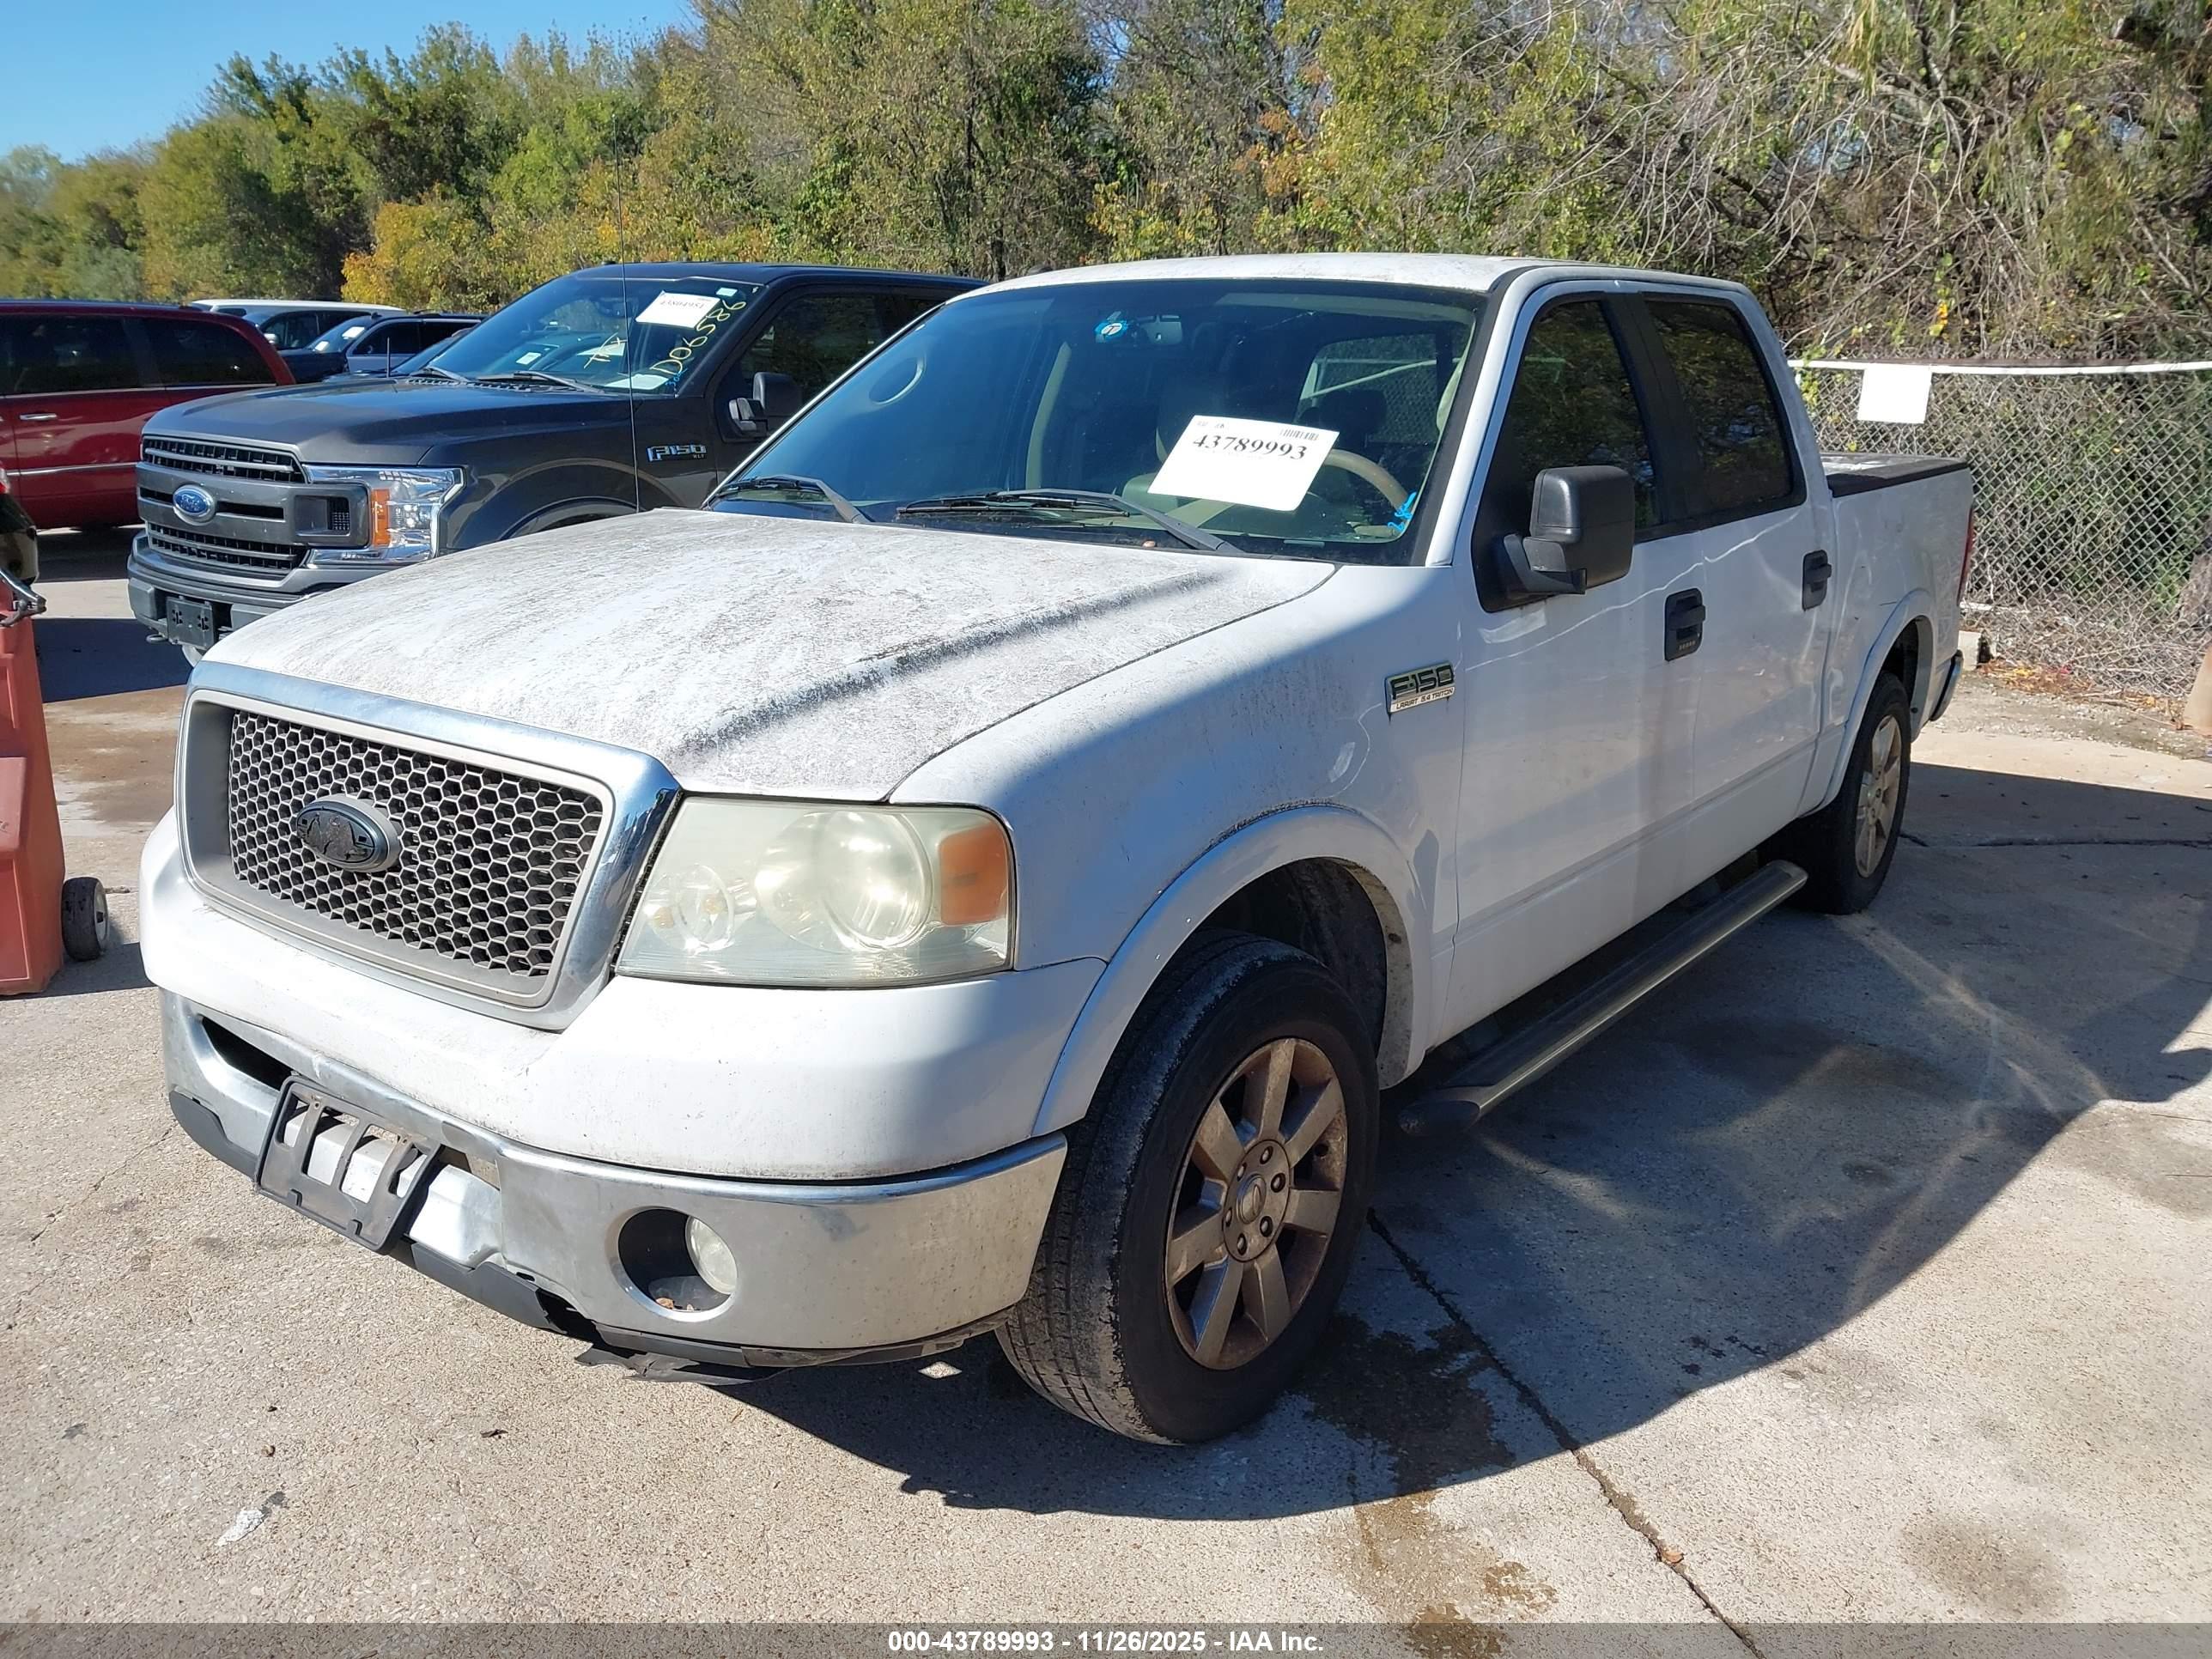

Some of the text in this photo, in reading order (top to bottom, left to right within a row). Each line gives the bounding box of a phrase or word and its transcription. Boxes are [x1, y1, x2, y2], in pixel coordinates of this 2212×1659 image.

[1193, 434, 1308, 460] 43789993
[1395, 687, 1454, 709] LARIAT 5.4 TRITON
